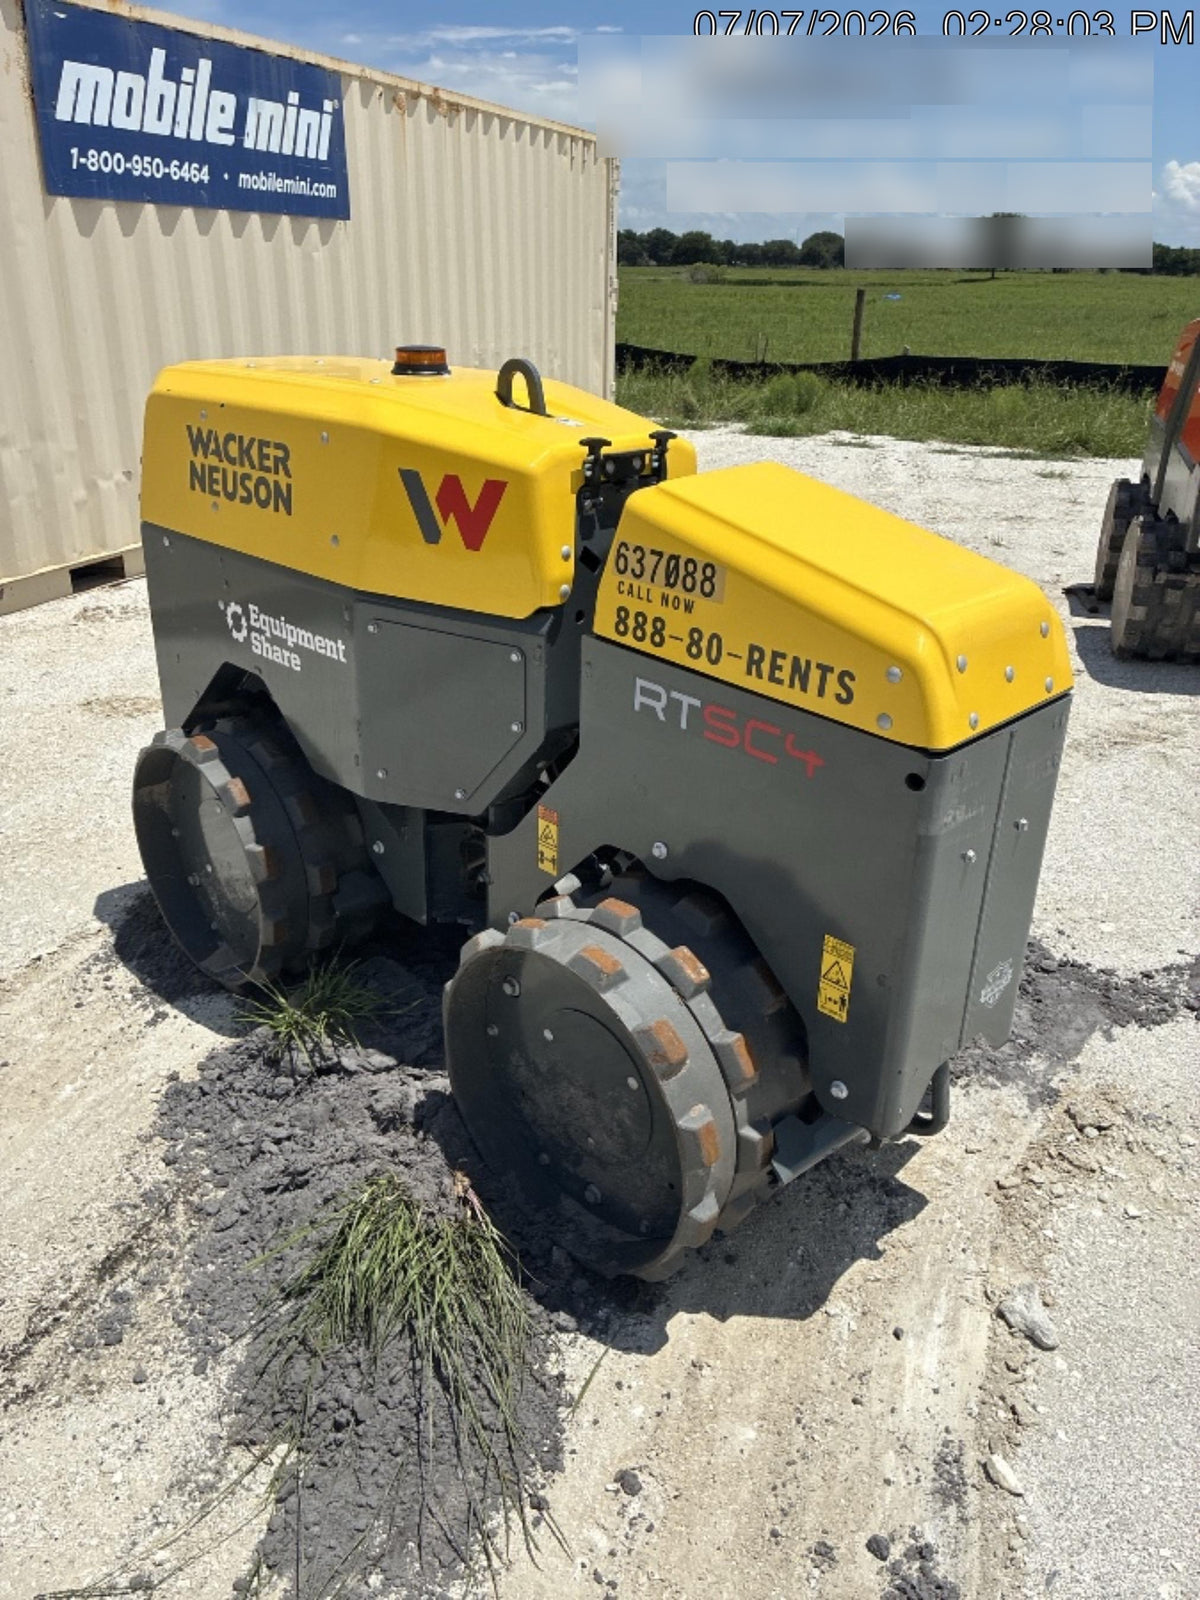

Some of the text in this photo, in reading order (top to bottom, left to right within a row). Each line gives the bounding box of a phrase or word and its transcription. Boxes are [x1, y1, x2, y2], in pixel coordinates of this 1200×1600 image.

[55, 47, 334, 161] mobile mini
[70, 147, 337, 199] 1-800-950-6464 mobilemini.com
[186, 424, 292, 479] WACKER
[189, 460, 292, 516] NEUSON
[617, 580, 695, 615] CALL NOW
[248, 603, 348, 664] Equipment
[251, 632, 302, 672] Share
[614, 605, 857, 706] 888-80-RENTS
